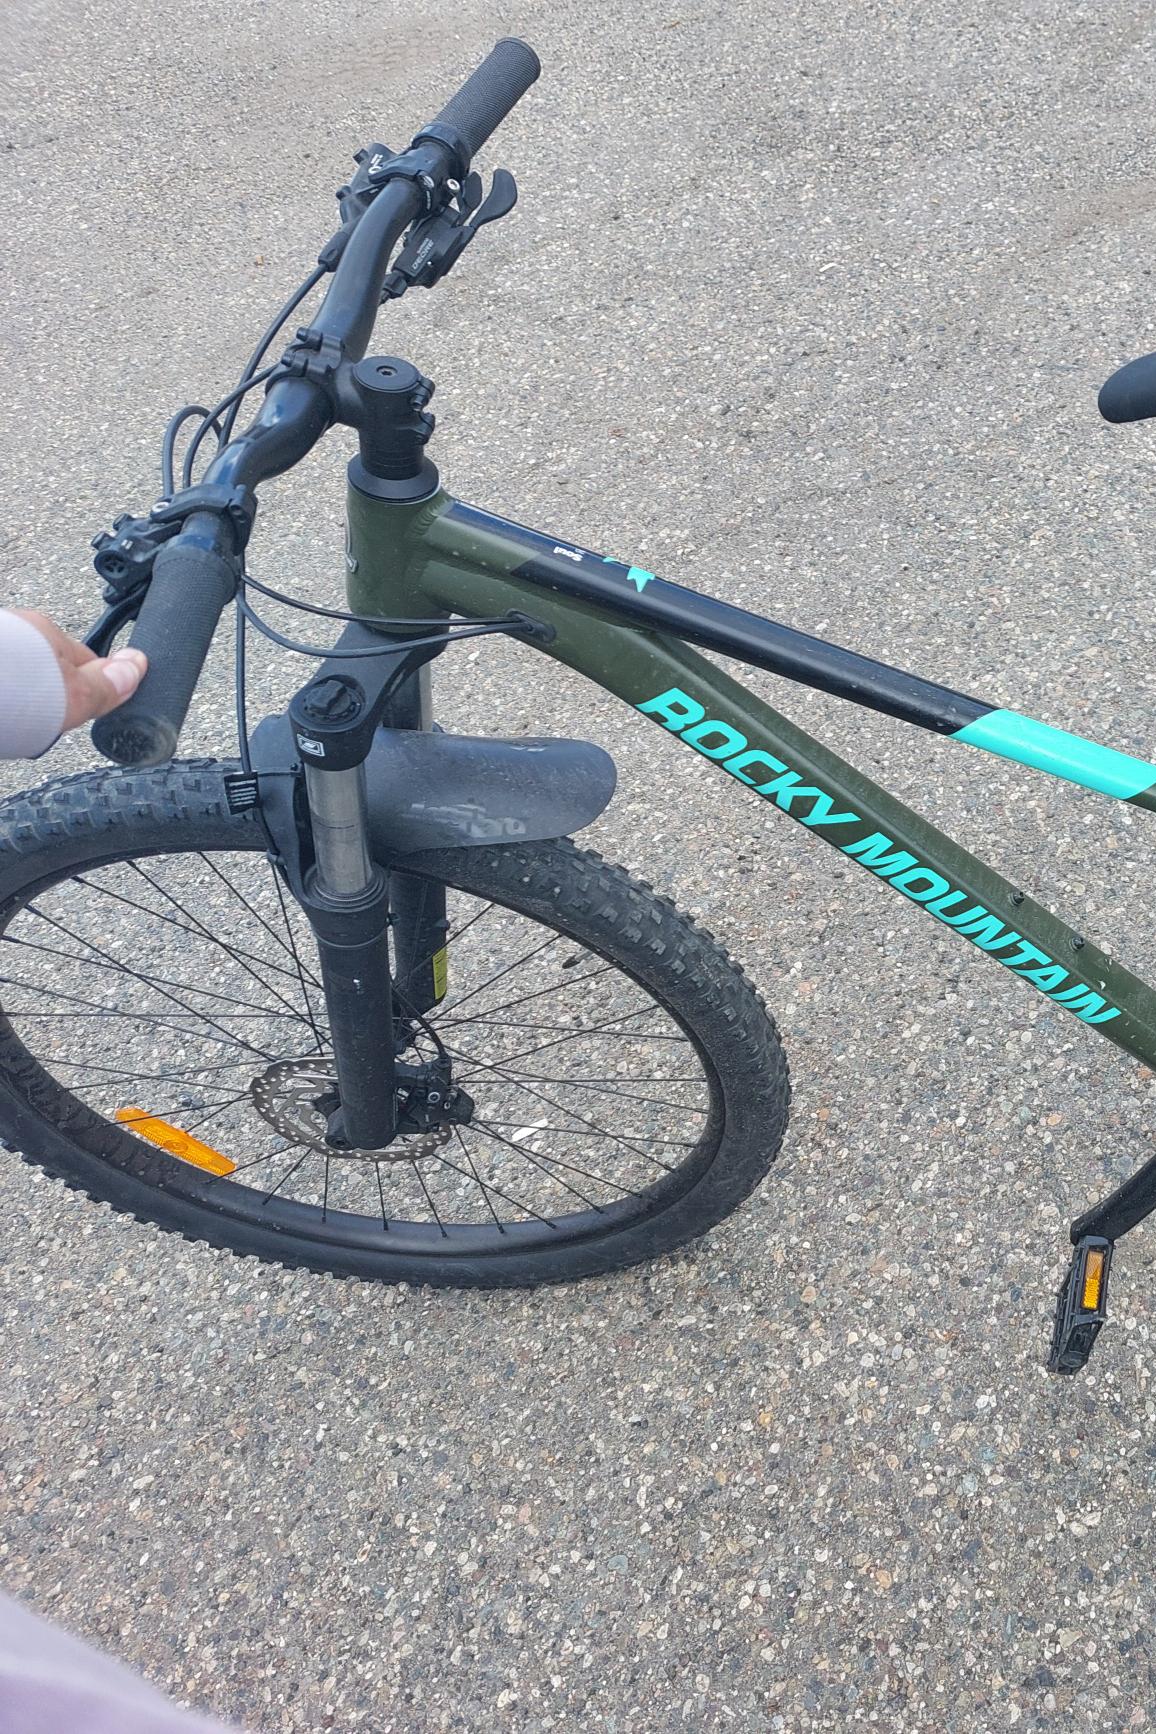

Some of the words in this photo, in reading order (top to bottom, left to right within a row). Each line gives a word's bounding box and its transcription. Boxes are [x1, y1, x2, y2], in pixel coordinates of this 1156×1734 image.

[553, 546, 583, 562] Soul
[636, 688, 860, 826] ROCKY
[840, 831, 1121, 1024] MOUNTAIN
